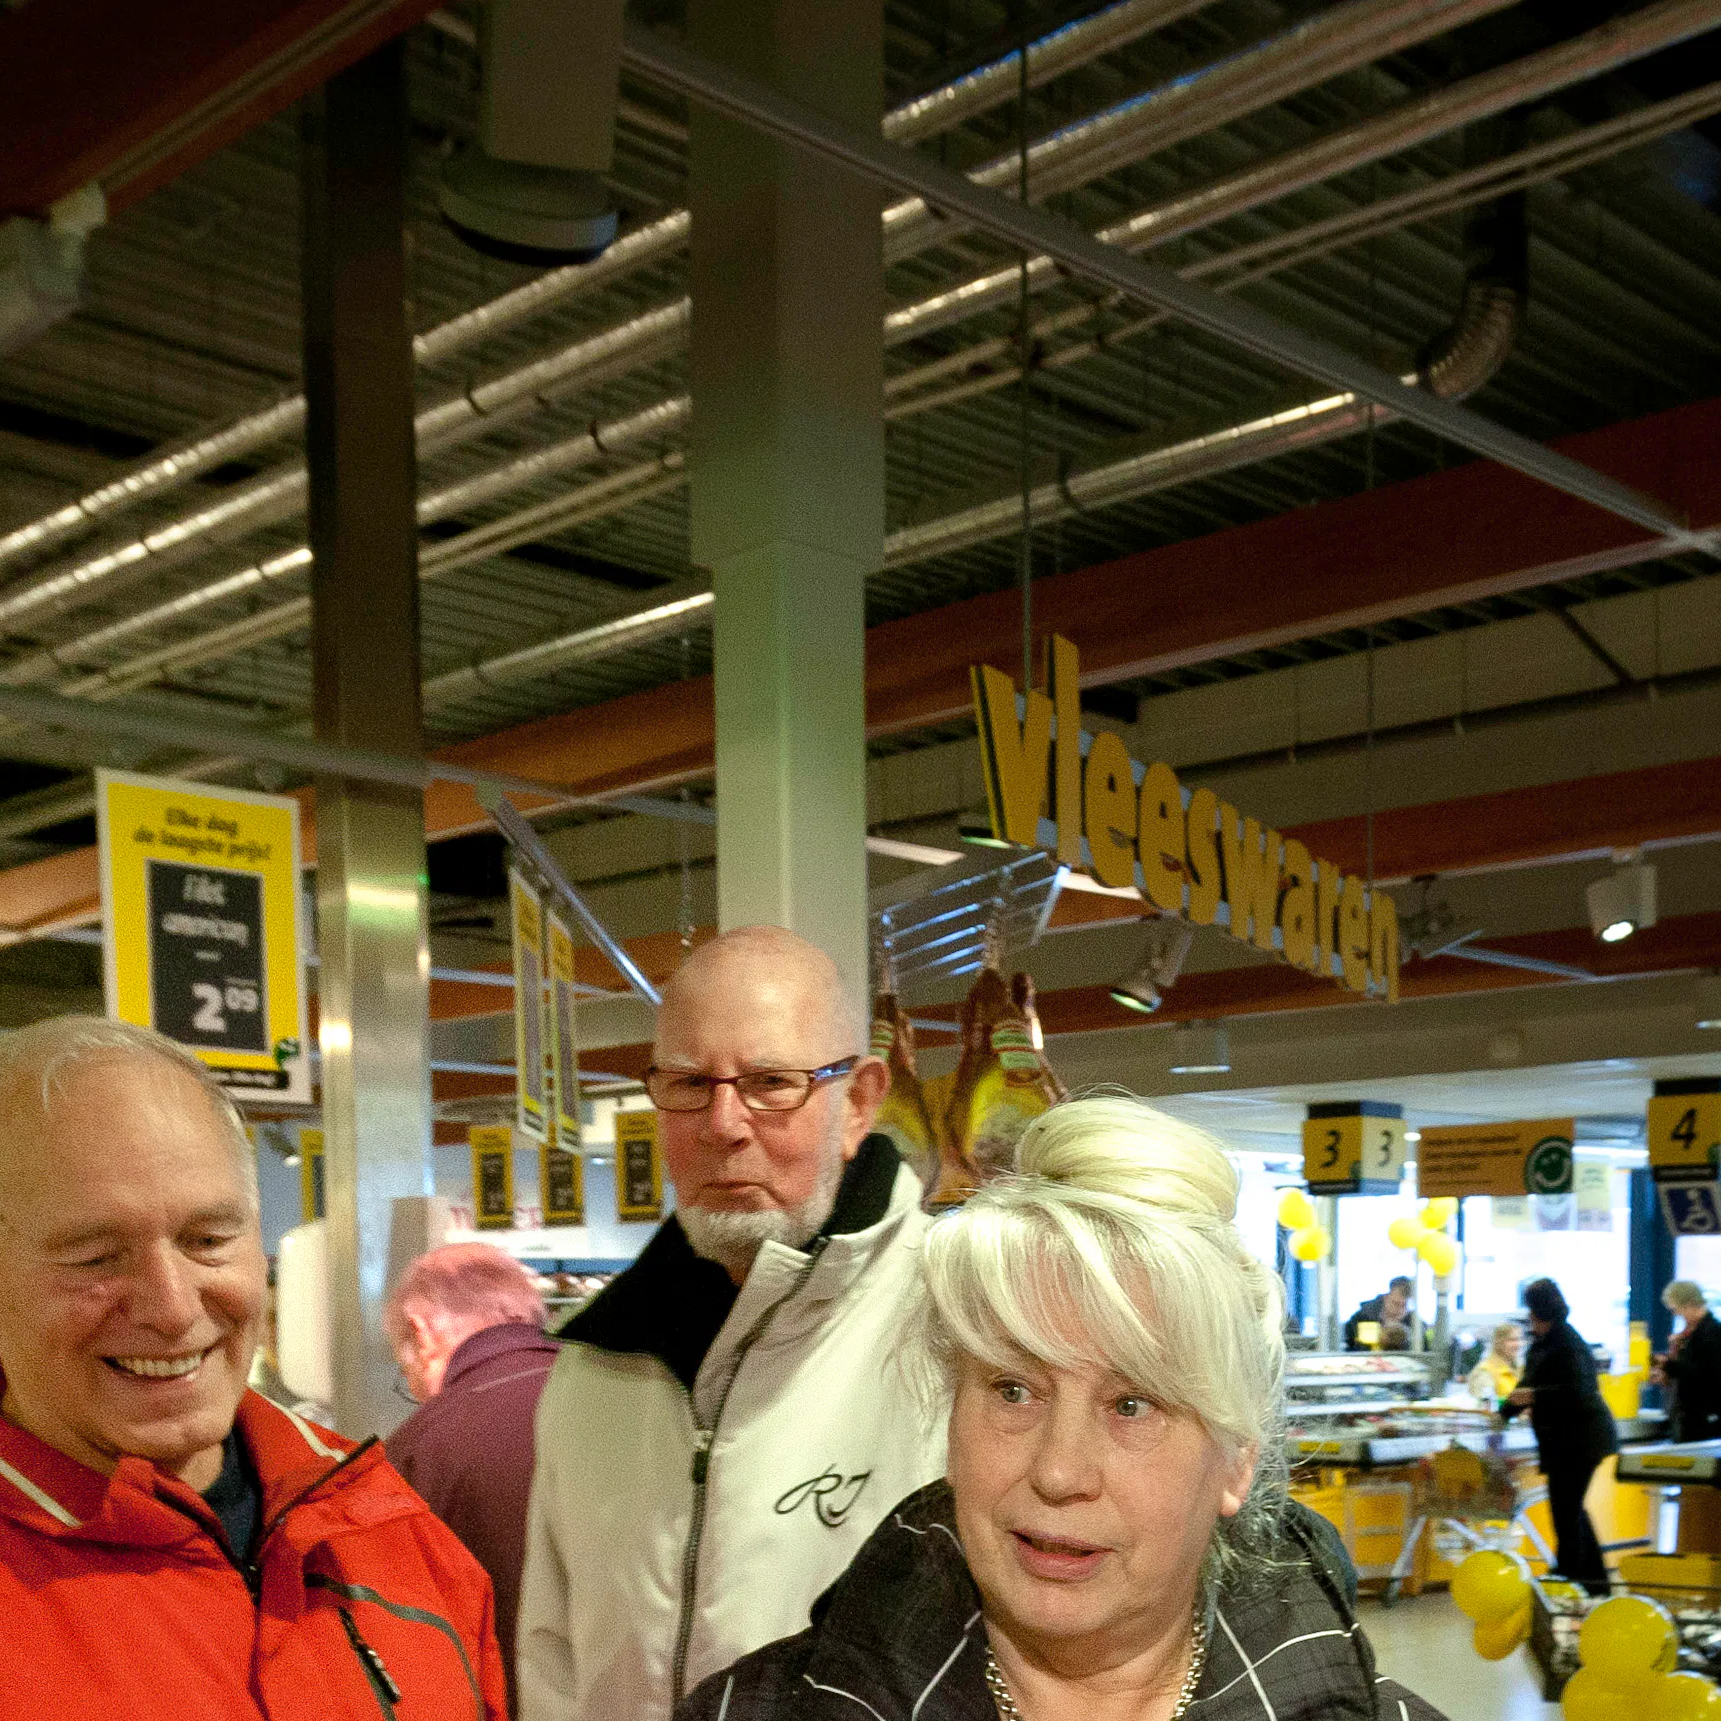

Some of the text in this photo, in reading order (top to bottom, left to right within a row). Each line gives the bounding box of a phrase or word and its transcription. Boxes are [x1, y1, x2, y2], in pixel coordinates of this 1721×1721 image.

[1319, 1129, 1342, 1168] 3
[1378, 1129, 1394, 1168] 3
[1671, 1107, 1699, 1151] 4
